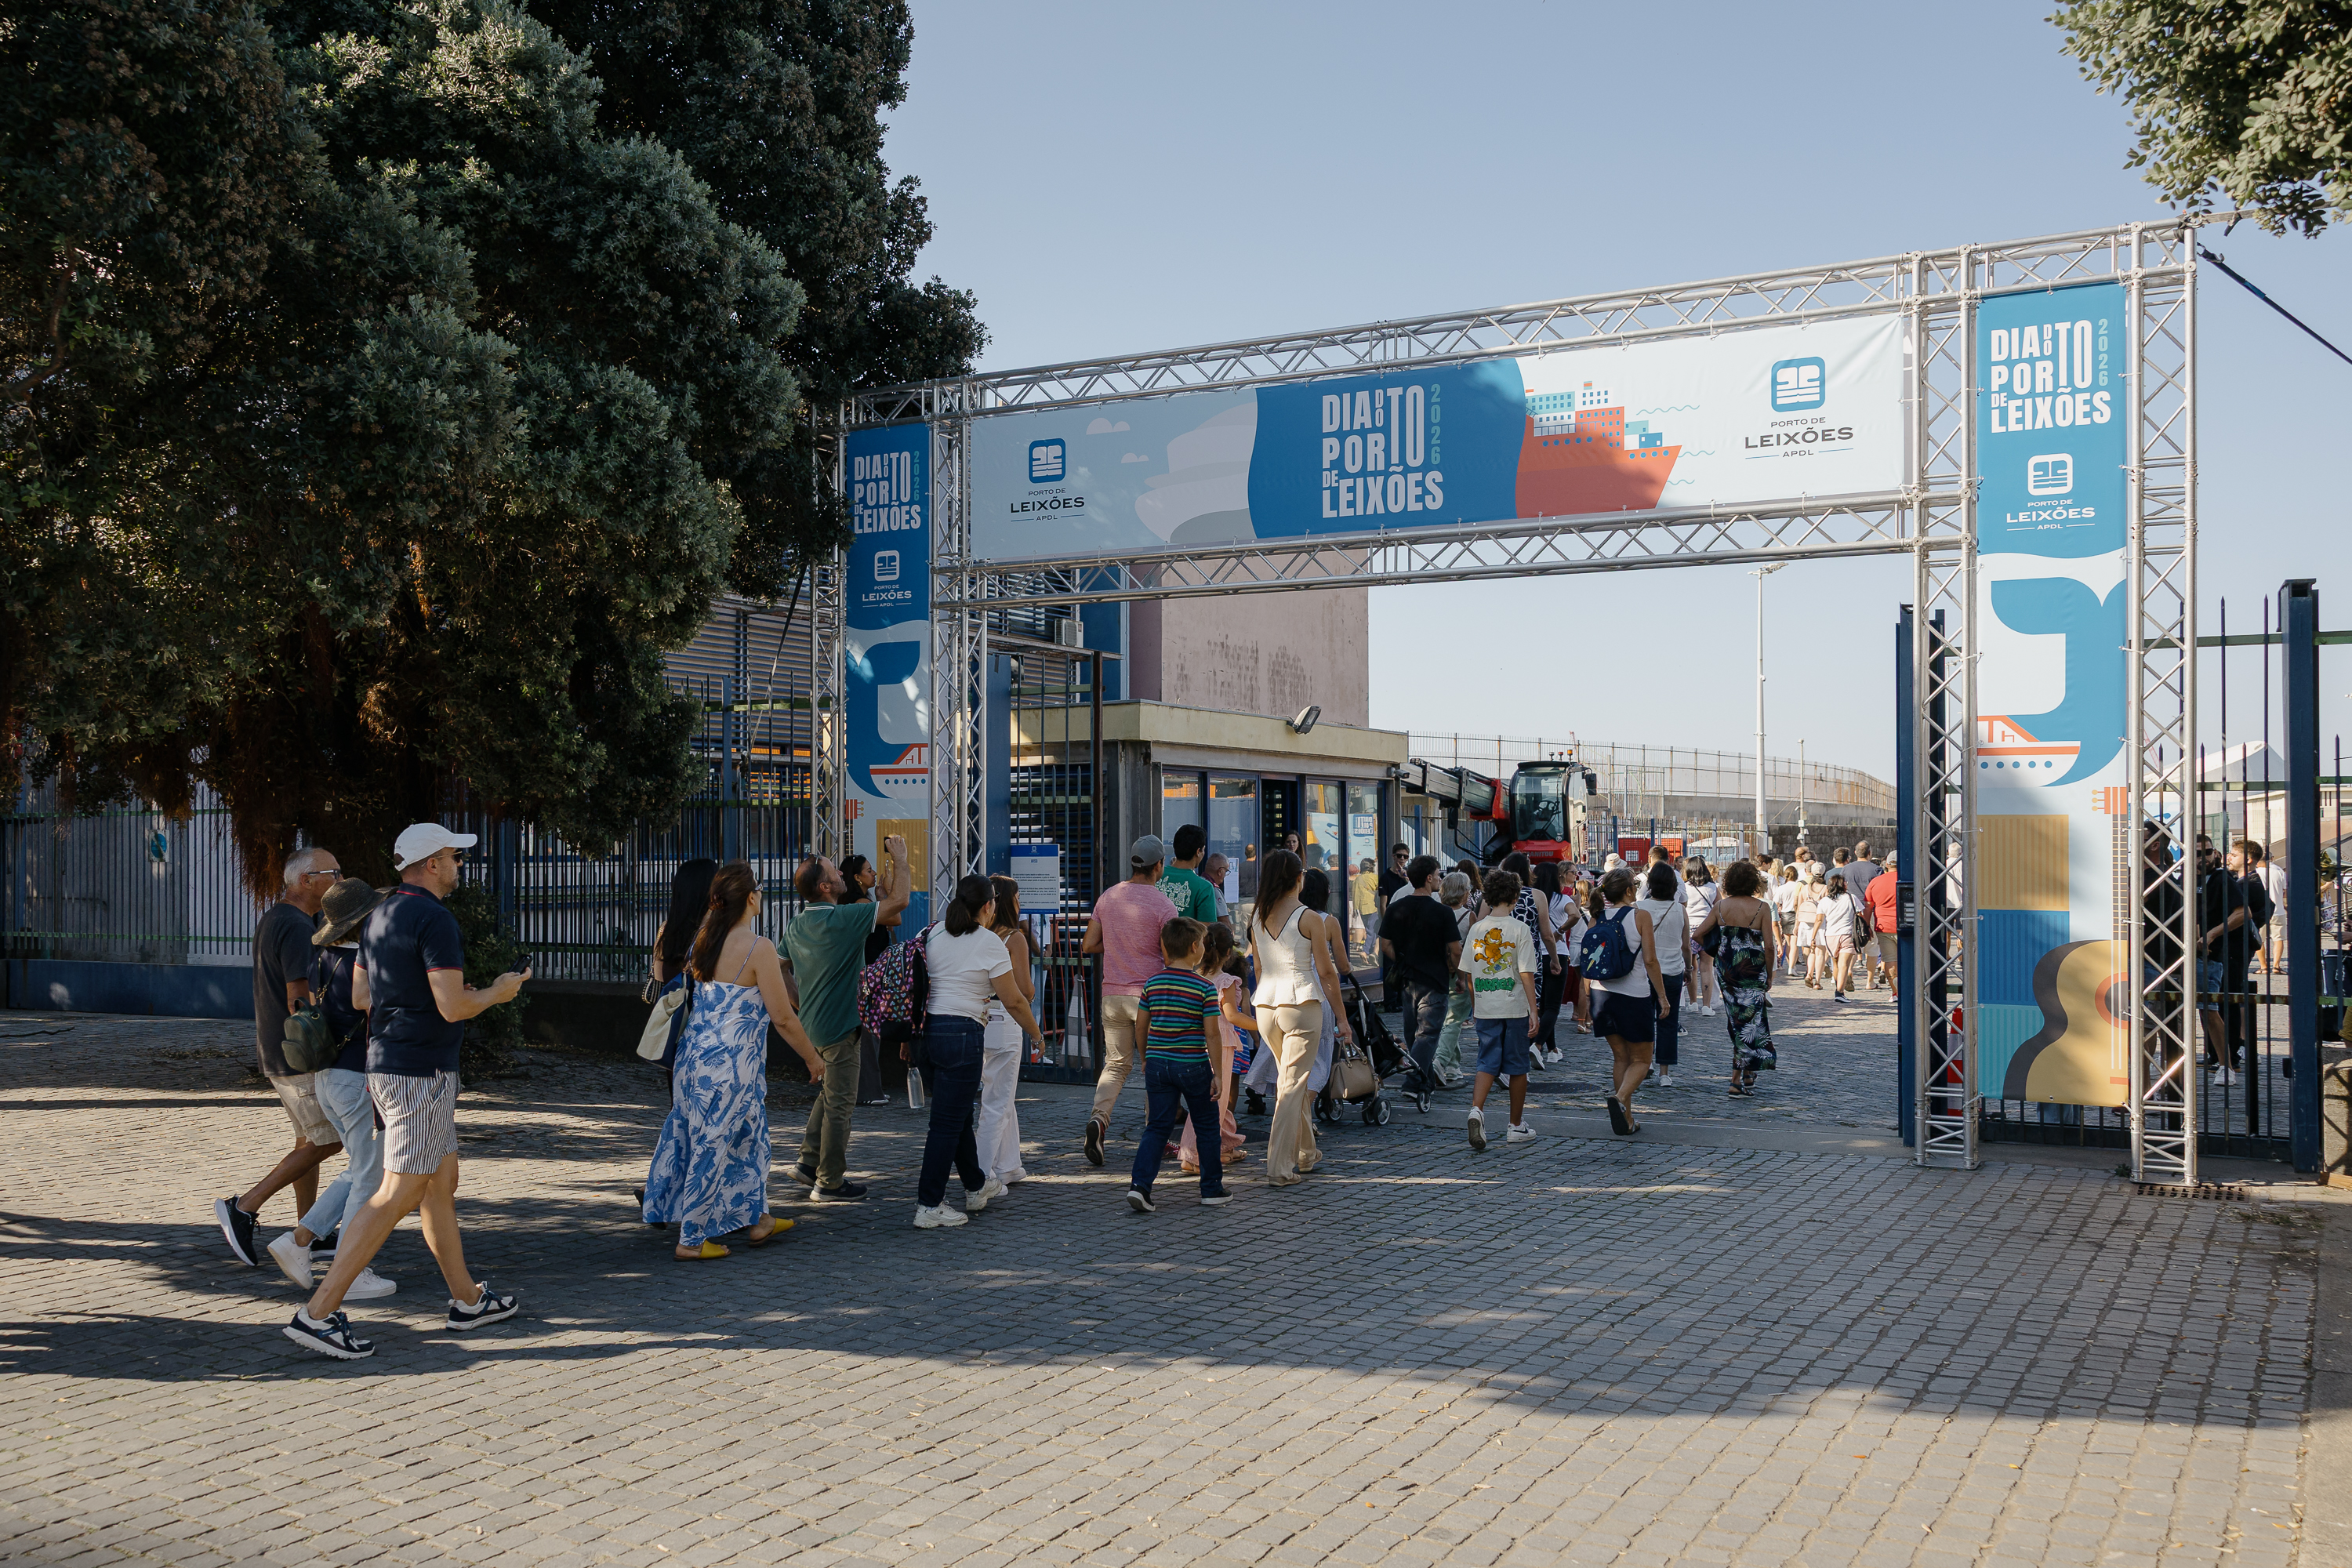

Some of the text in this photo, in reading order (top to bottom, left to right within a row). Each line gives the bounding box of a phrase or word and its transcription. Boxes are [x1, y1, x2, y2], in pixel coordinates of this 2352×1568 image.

[1991, 325, 2041, 362] DIA
[2098, 318, 2108, 387] 2026
[1991, 320, 2092, 395] PORTO
[1322, 390, 1372, 433] DIA
[1991, 392, 2007, 408] DE
[1991, 387, 2111, 434] LEIXÕES
[1322, 385, 1425, 474] PORTO
[1431, 383, 1441, 465] 2026
[1770, 418, 1808, 428] PORTO
[1744, 426, 1853, 449] LEIXÕES
[1782, 449, 1814, 458] APDL
[854, 451, 911, 506] PORTO
[855, 454, 882, 481] DIA
[1322, 470, 1338, 488] DE
[1322, 465, 1444, 518] LEIXÕES
[2027, 499, 2059, 508] PORTO
[854, 503, 863, 515] DE
[1011, 495, 1086, 514] LEIXÕES
[2006, 506, 2096, 523] LEIXÕES
[854, 501, 921, 534] LEIXÕES
[862, 590, 913, 601] LEIXÕES
[1474, 977, 1515, 993] GARFIELD
